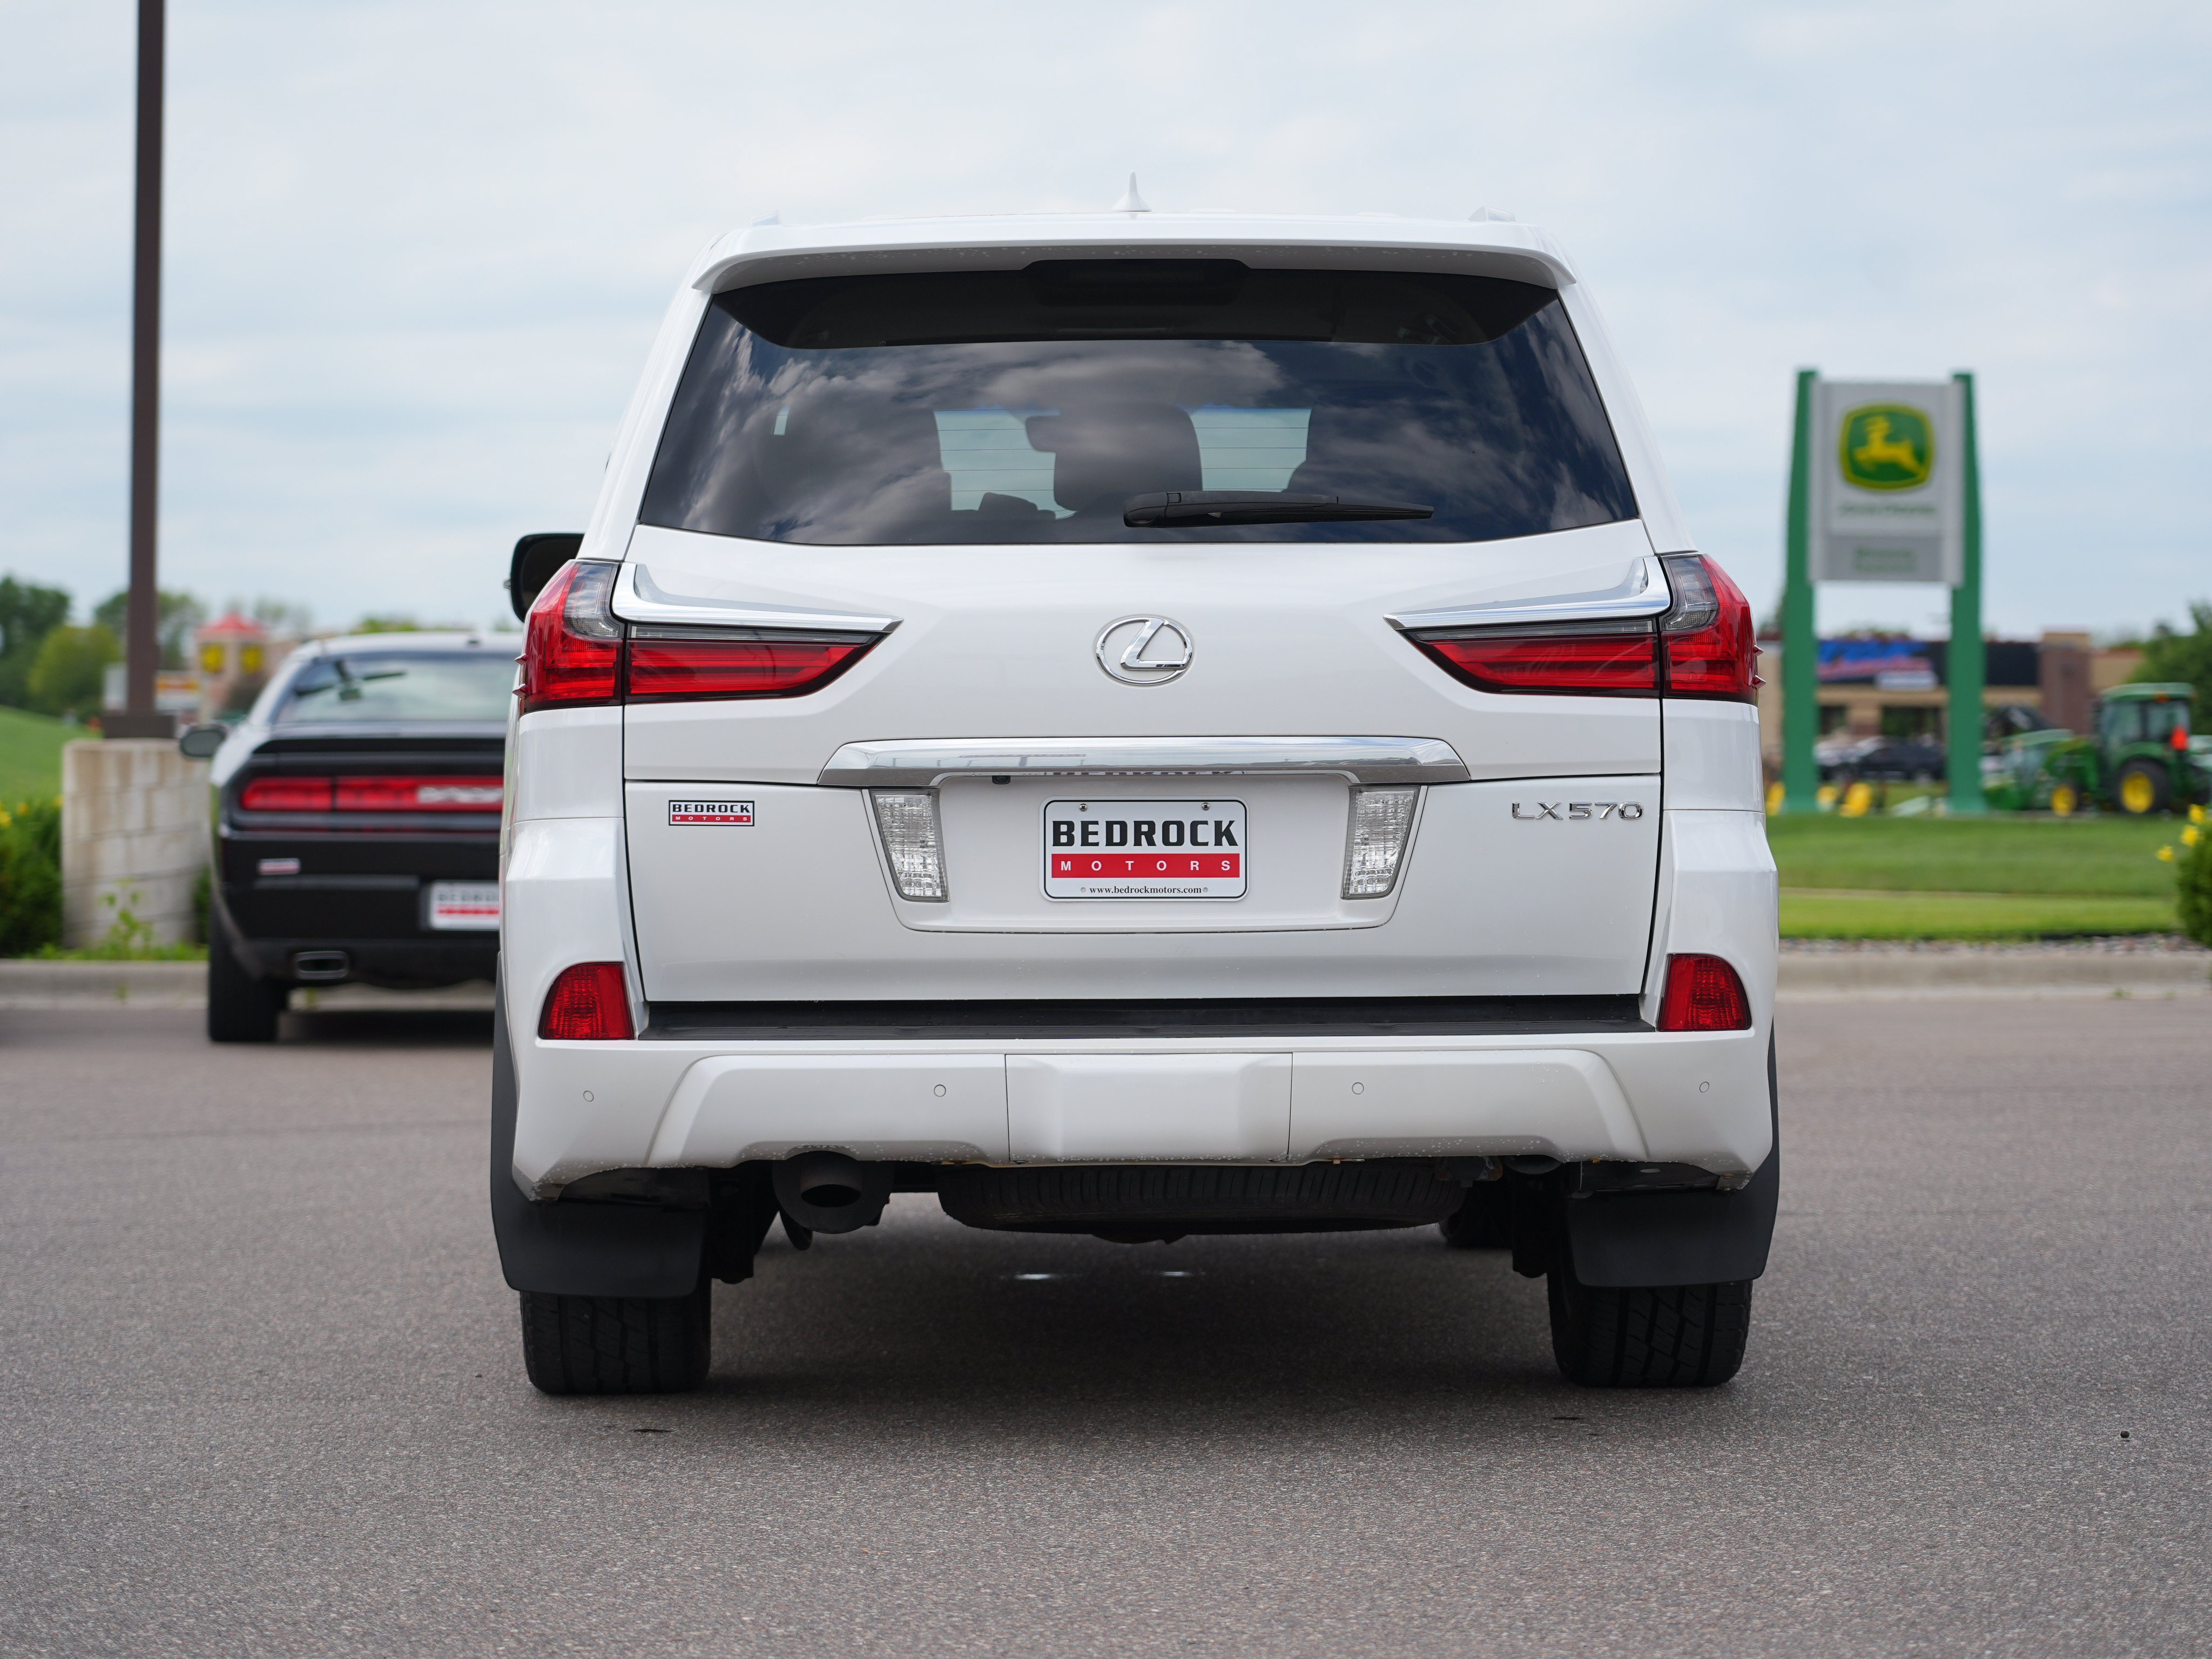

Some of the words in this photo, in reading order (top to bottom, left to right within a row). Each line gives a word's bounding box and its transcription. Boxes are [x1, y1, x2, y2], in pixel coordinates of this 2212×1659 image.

[672, 804, 751, 813] BEDROCK
[1052, 820, 1239, 847] BEDROCK
[1061, 860, 1231, 871] MOTORS
[1089, 886, 1202, 894] www.bedrockmotors.com
